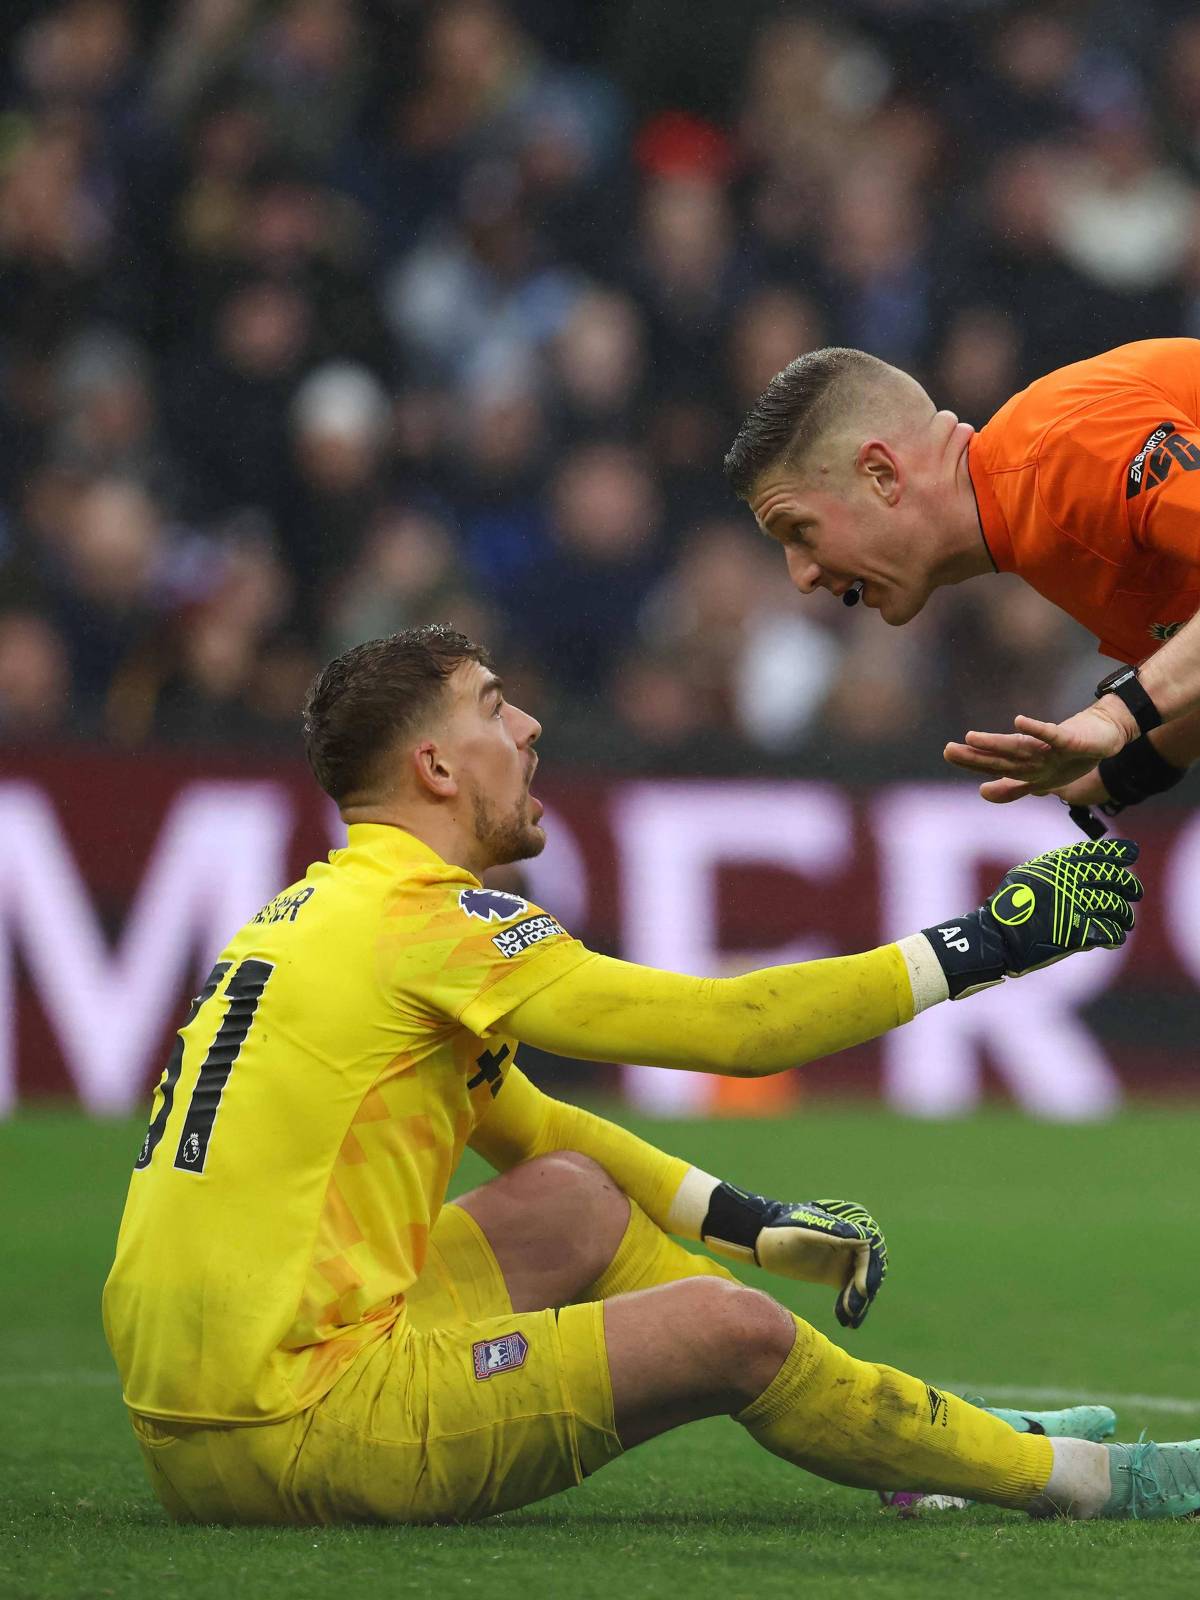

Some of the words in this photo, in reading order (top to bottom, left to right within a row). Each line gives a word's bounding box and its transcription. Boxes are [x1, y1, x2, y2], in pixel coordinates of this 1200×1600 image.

[491, 929, 518, 951] No
[518, 915, 554, 937] room
[937, 925, 971, 954] AP
[502, 937, 525, 959] for
